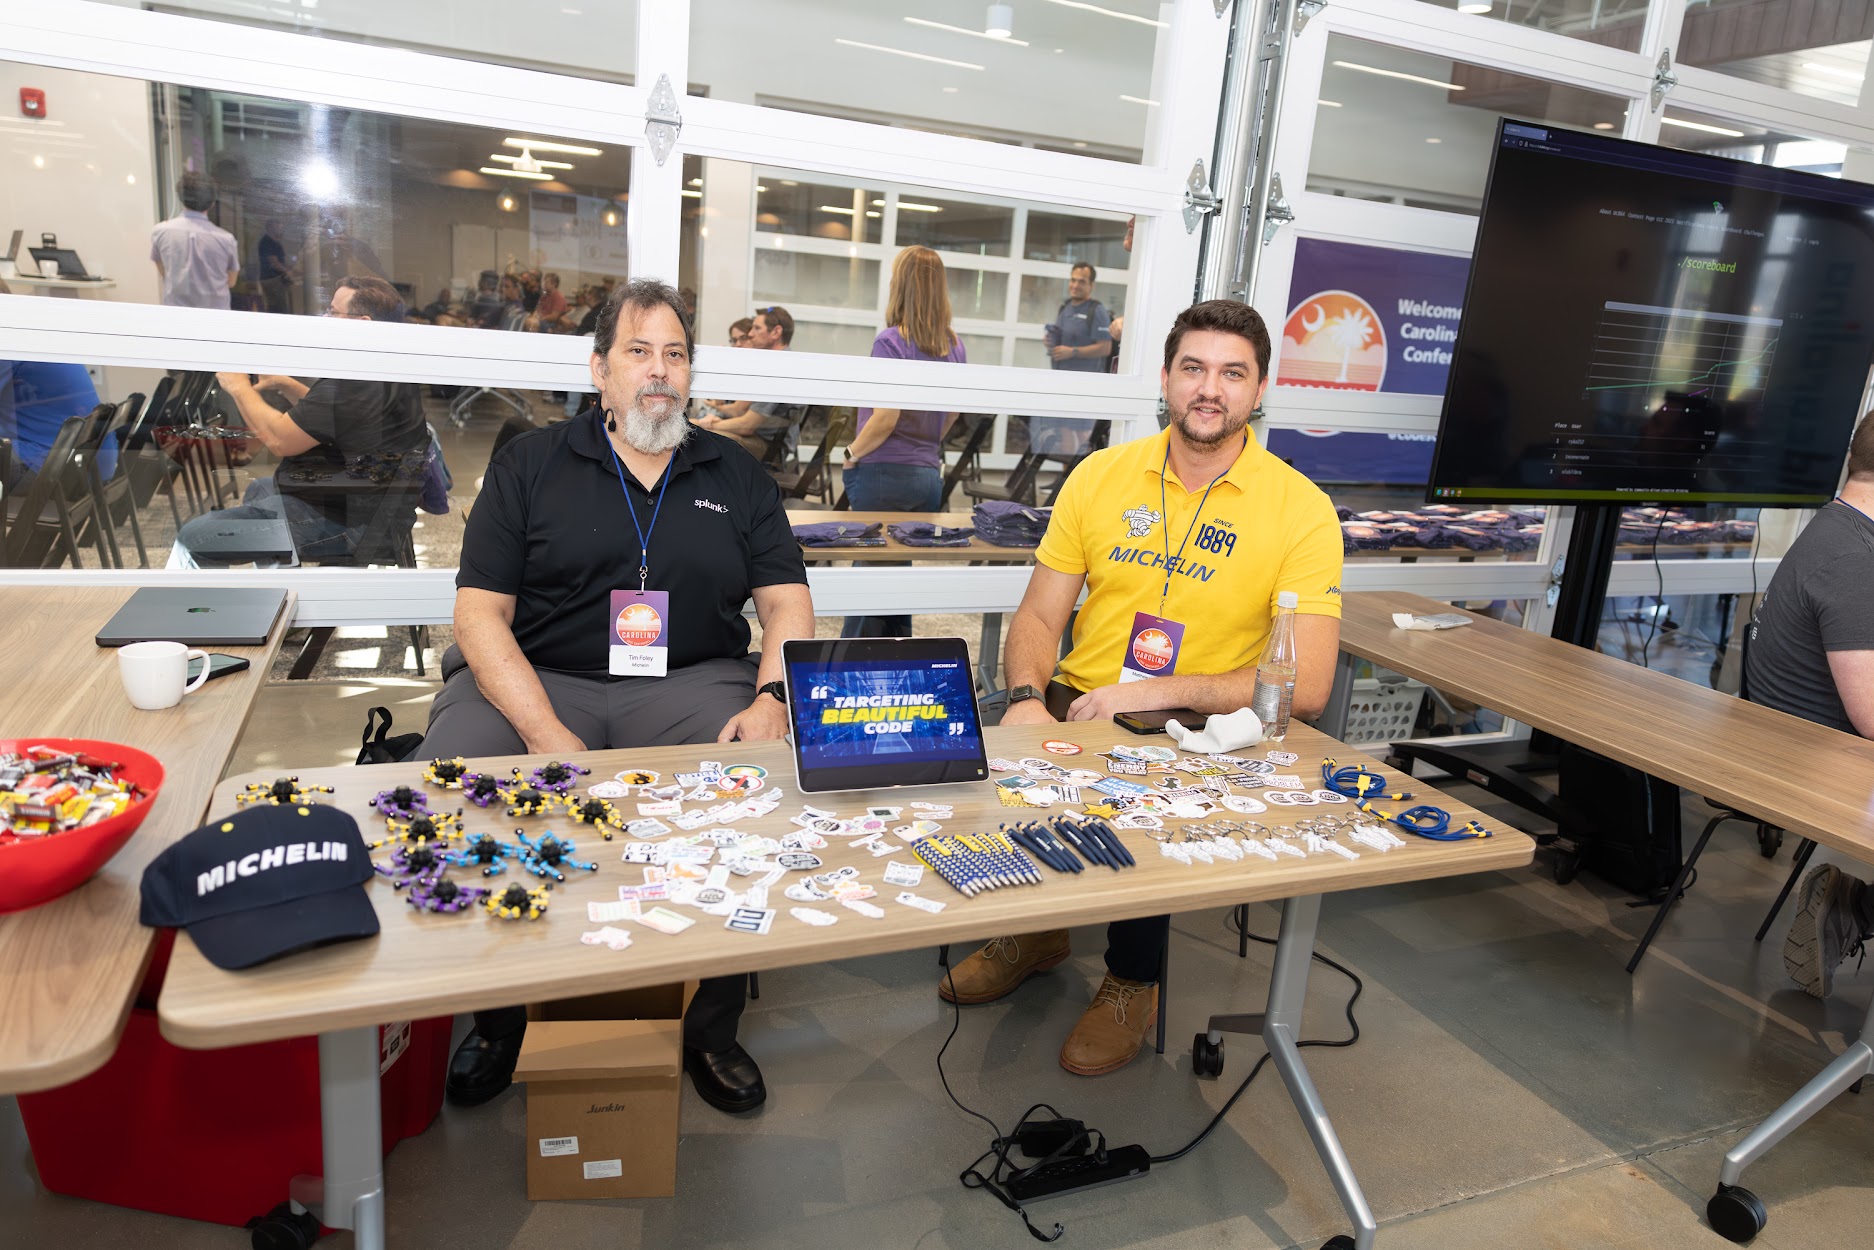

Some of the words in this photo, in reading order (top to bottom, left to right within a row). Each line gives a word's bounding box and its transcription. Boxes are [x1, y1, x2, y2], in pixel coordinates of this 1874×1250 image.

[1677, 256, 1736, 273] ./scoreboard
[1400, 322, 1458, 342] Carolin
[1213, 517, 1234, 528] SINCE
[1194, 523, 1238, 557] 1889
[1108, 546, 1216, 582] MICHELIN
[621, 631, 656, 639] CAROLINA
[1136, 650, 1166, 665] CAROLINA
[833, 693, 935, 708] TARGETING
[821, 705, 948, 724] BEAUTIFUL
[864, 721, 913, 735] CODE
[1263, 780, 1303, 788] PROBLEM
[196, 841, 348, 896] MICHELIN
[586, 1103, 626, 1114] Junkin
